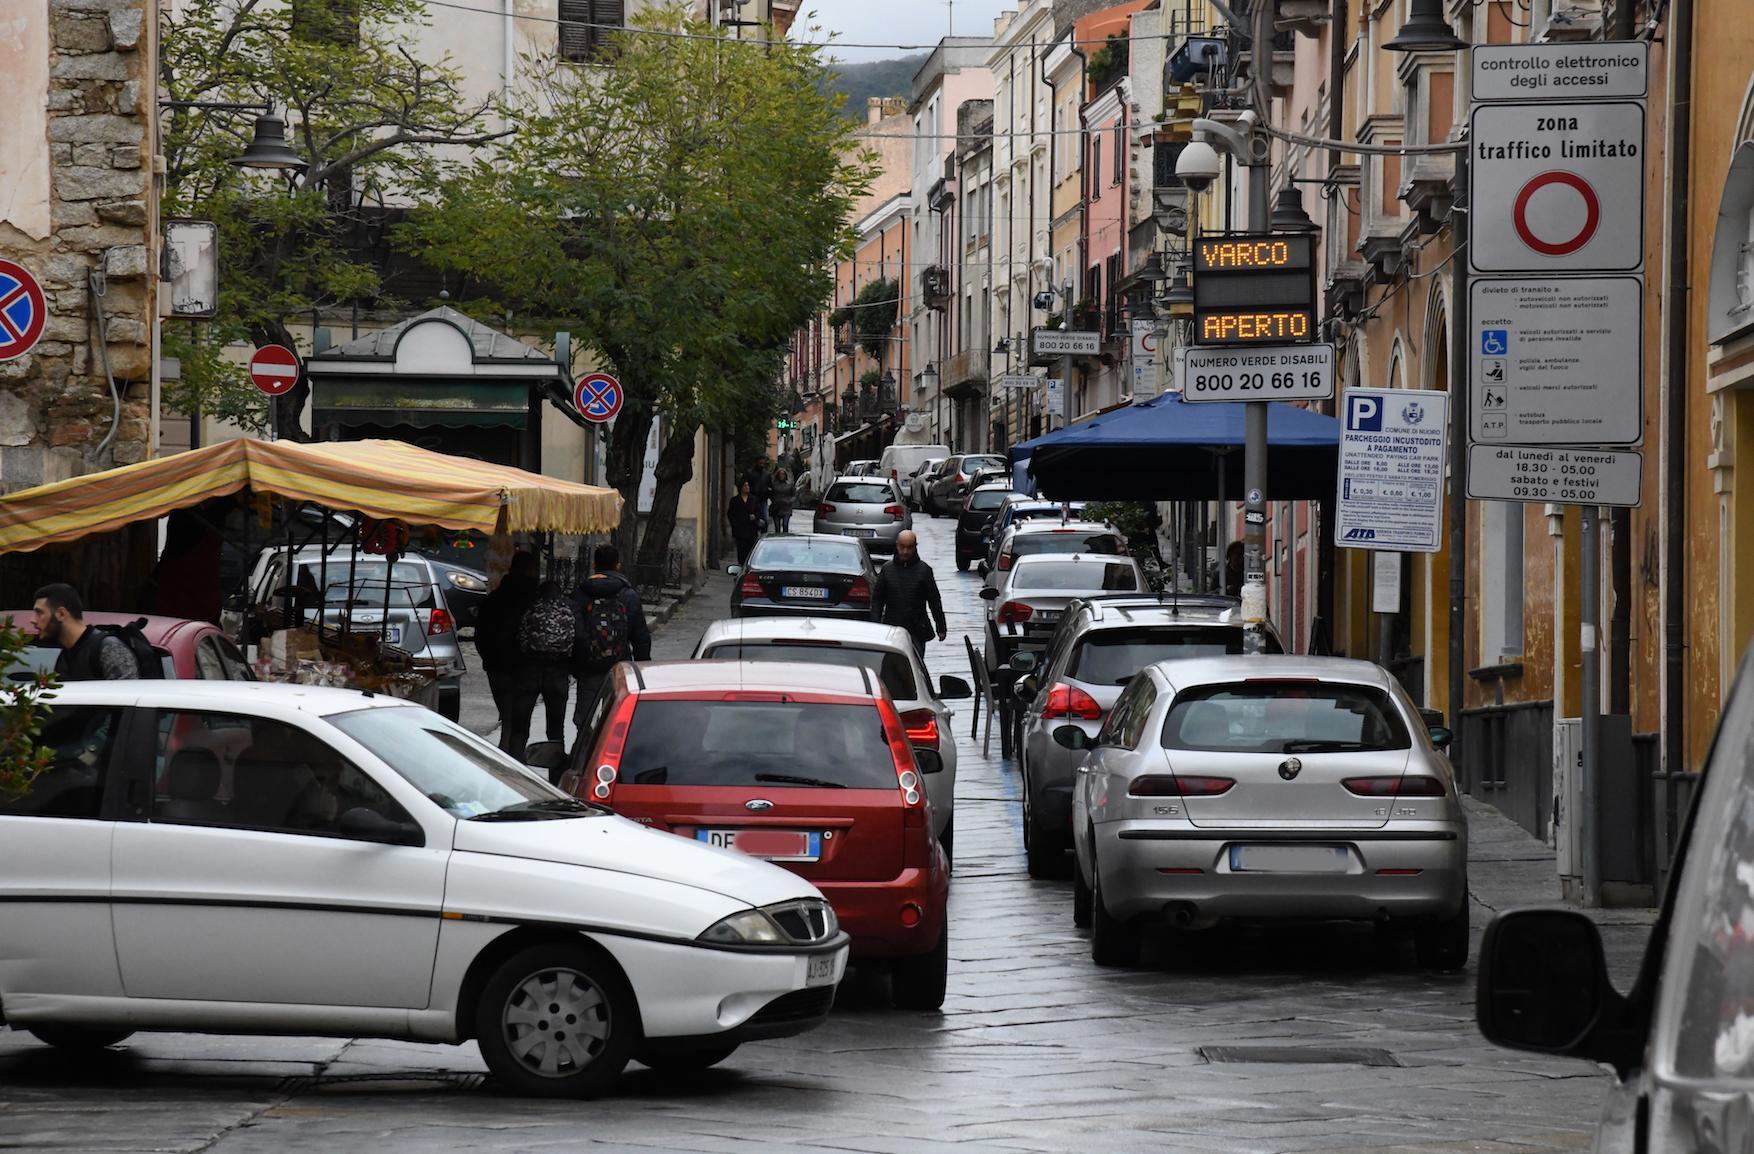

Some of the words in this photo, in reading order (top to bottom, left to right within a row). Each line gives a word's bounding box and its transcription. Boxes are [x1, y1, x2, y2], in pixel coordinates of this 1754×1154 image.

[1481, 56, 1550, 71] controllo
[1555, 55, 1639, 68] elettronico
[1510, 74, 1548, 88] degli
[1552, 72, 1609, 86] accessi
[1537, 117, 1578, 131] zona
[1478, 142, 1551, 159] traffico
[1561, 140, 1637, 159] limitato
[1202, 242, 1288, 267] VARCO
[1203, 313, 1306, 339] APERTO
[1190, 357, 1238, 368] NUMERO
[1241, 355, 1277, 366] VERDE
[1280, 354, 1328, 365] DISABILI
[1195, 374, 1233, 391] 800
[1239, 373, 1264, 390] 20
[1271, 372, 1294, 389] 66
[1301, 371, 1321, 388] 16
[1352, 398, 1377, 430] P
[1345, 434, 1391, 444] PARCHEGGIO
[1392, 437, 1441, 446] INCUSTODITO
[1374, 445, 1418, 454] PAGAMENTO
[1496, 450, 1514, 459] dal
[1558, 452, 1570, 462] al
[1516, 463, 1548, 474] 18.30
[1561, 465, 1596, 475] 05.00
[1510, 475, 1548, 486] sabato
[1552, 477, 1559, 486] e
[1563, 477, 1600, 488] festivi
[1513, 486, 1548, 497] 09.30
[1561, 489, 1596, 499] 05.00
